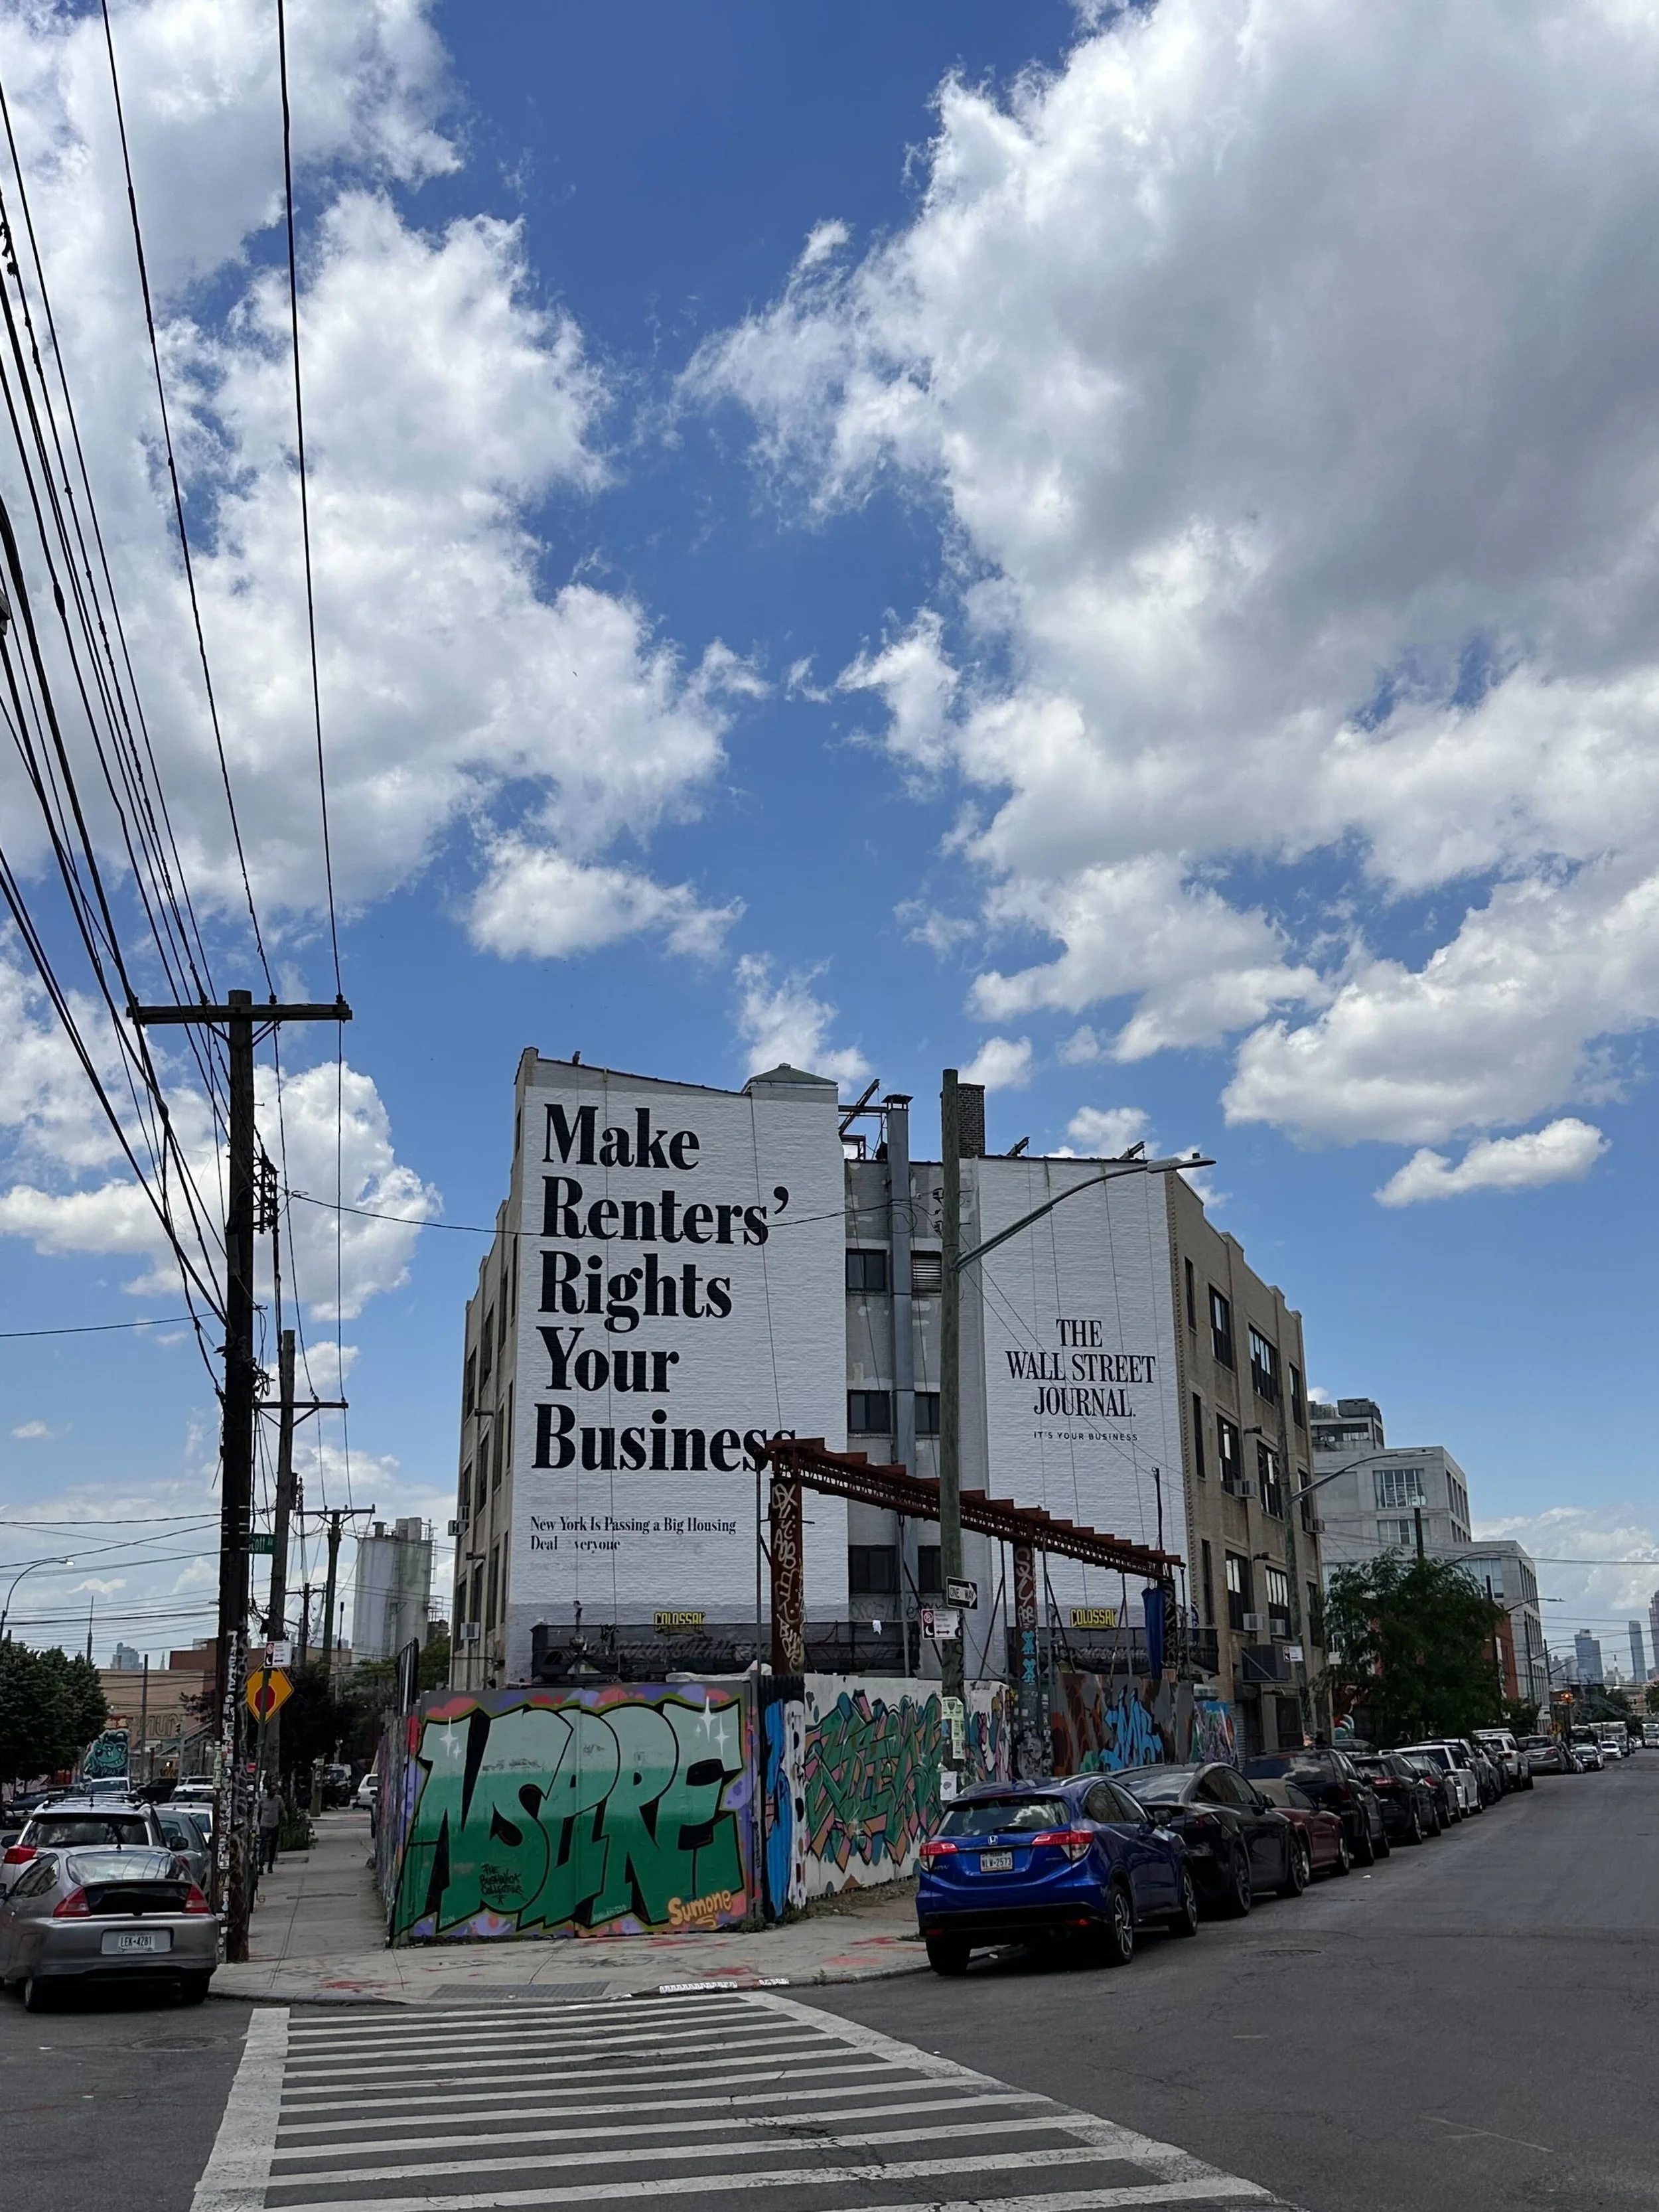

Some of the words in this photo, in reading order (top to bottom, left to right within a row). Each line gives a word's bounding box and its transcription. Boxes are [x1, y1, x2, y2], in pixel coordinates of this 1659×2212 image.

[542, 1103, 699, 1170] Make
[540, 1175, 789, 1246] Renters’
[538, 1250, 733, 1333] Rights
[1056, 1319, 1103, 1347] THE
[536, 1326, 680, 1392] Your
[1005, 1351, 1066, 1380] WALL
[1072, 1353, 1156, 1384] STREET
[531, 1516, 556, 1531] New
[559, 1516, 587, 1532] York
[591, 1516, 601, 1532] Is
[605, 1517, 650, 1535] Passing
[653, 1521, 661, 1532] a
[664, 1517, 684, 1536] Big
[687, 1517, 737, 1535] Housing
[531, 1535, 557, 1550] Deal
[950, 1587, 960, 1598] ONE
[964, 1589, 974, 1600] WAY
[1070, 1609, 1116, 1627] COLOSSAL
[668, 1890, 731, 1925] Sumone
